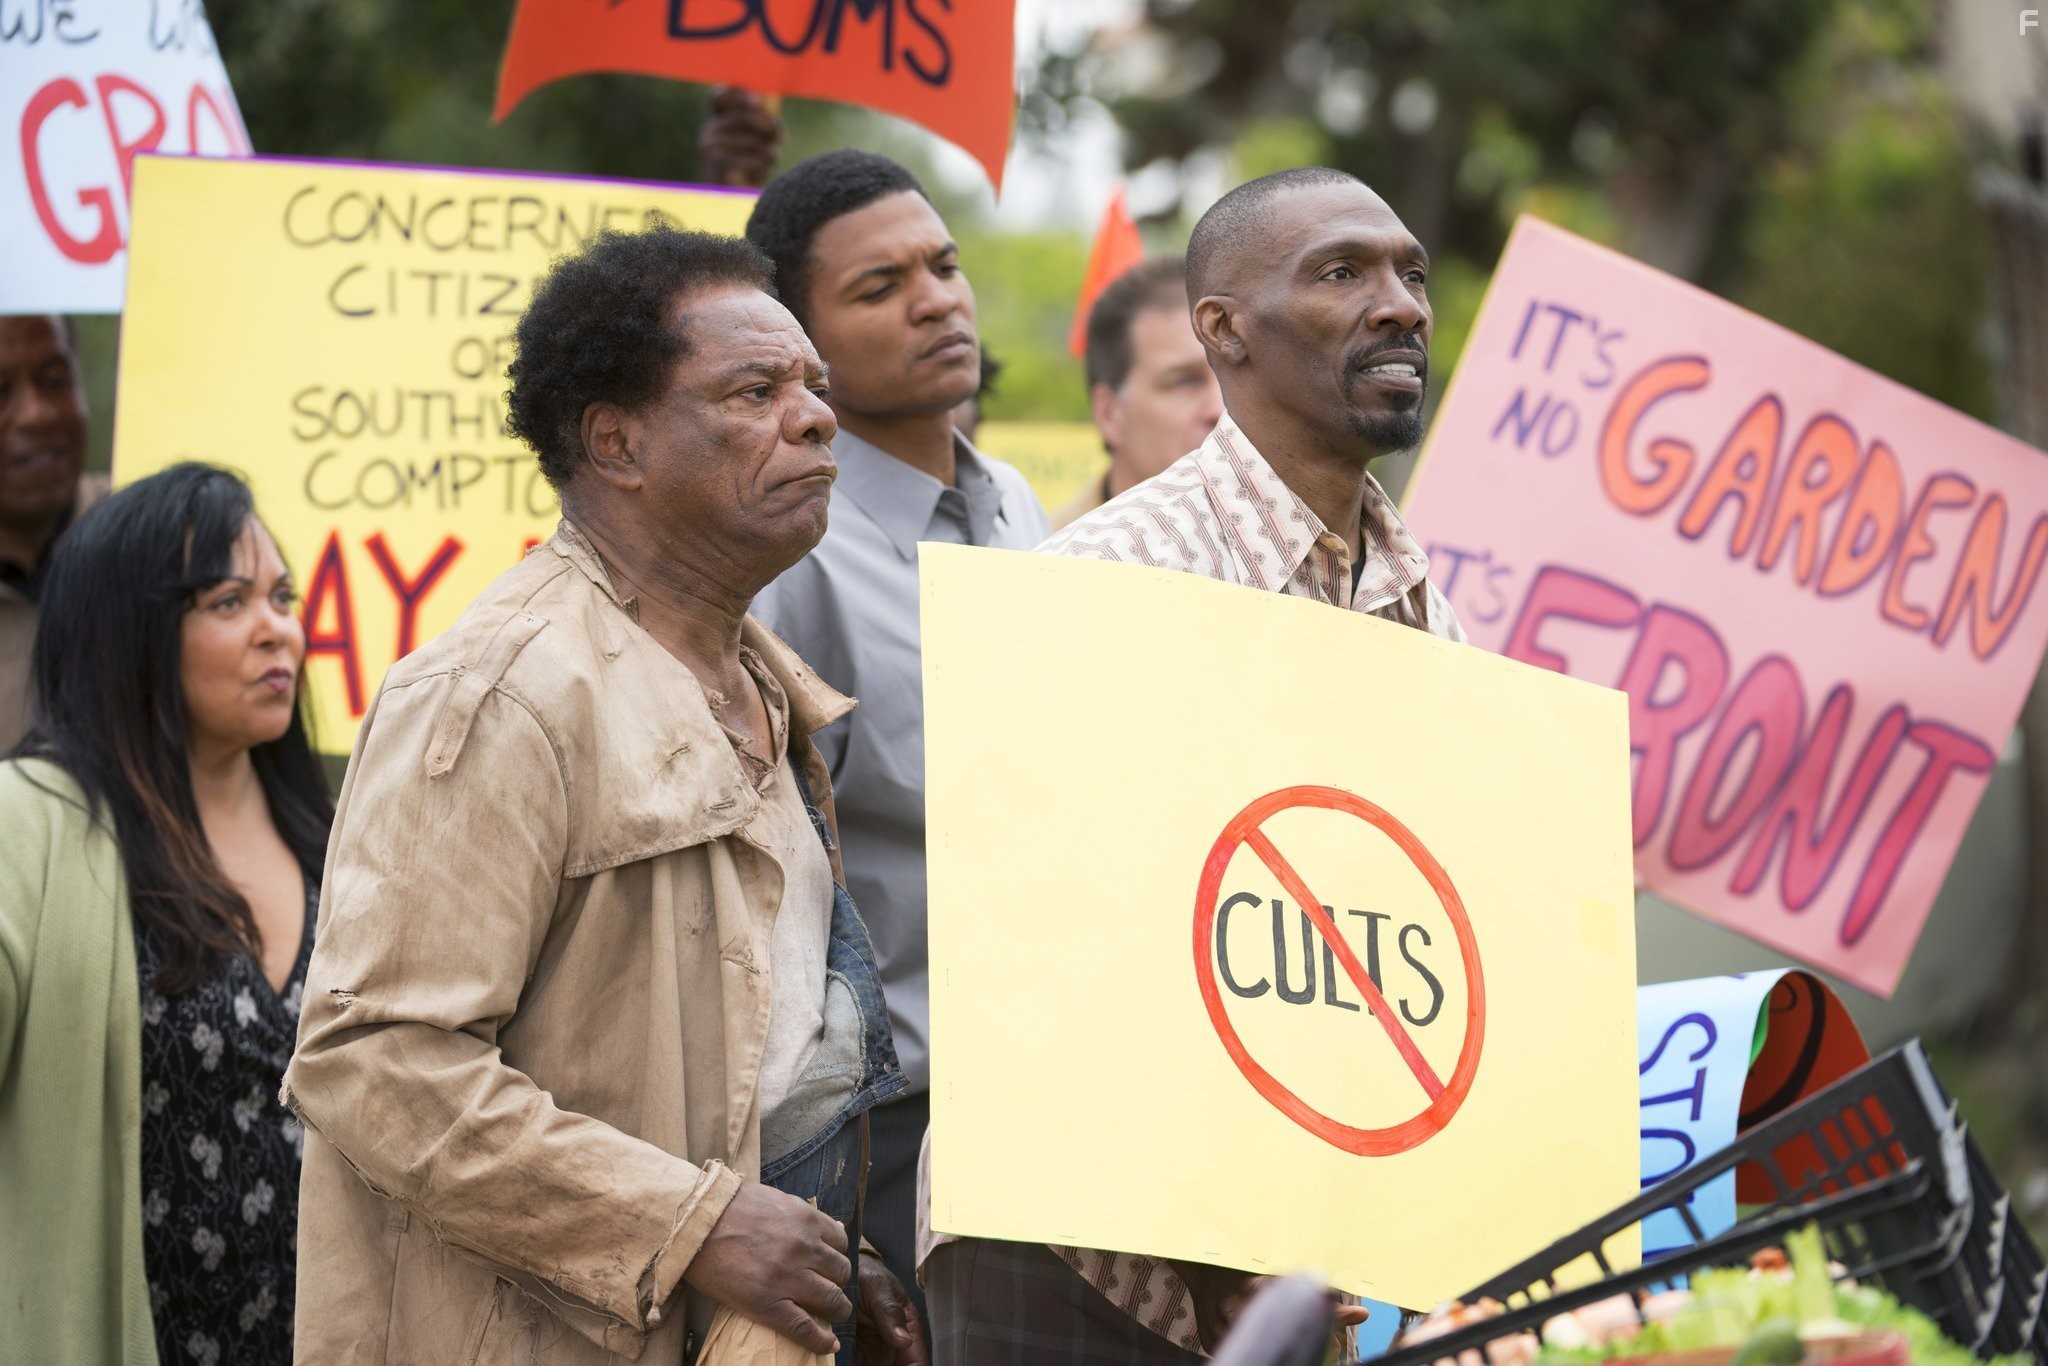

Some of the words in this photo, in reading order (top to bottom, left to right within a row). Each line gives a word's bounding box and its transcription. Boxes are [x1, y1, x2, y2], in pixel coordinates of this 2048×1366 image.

[328, 264, 550, 318] CITIZ
[1511, 300, 1625, 389] IT'S
[291, 384, 510, 443] SOUTH
[1491, 387, 1580, 458] NO
[1597, 353, 2048, 663] GARDEN
[1501, 563, 1994, 951] FRONT
[1215, 891, 1446, 1027] CULTS
